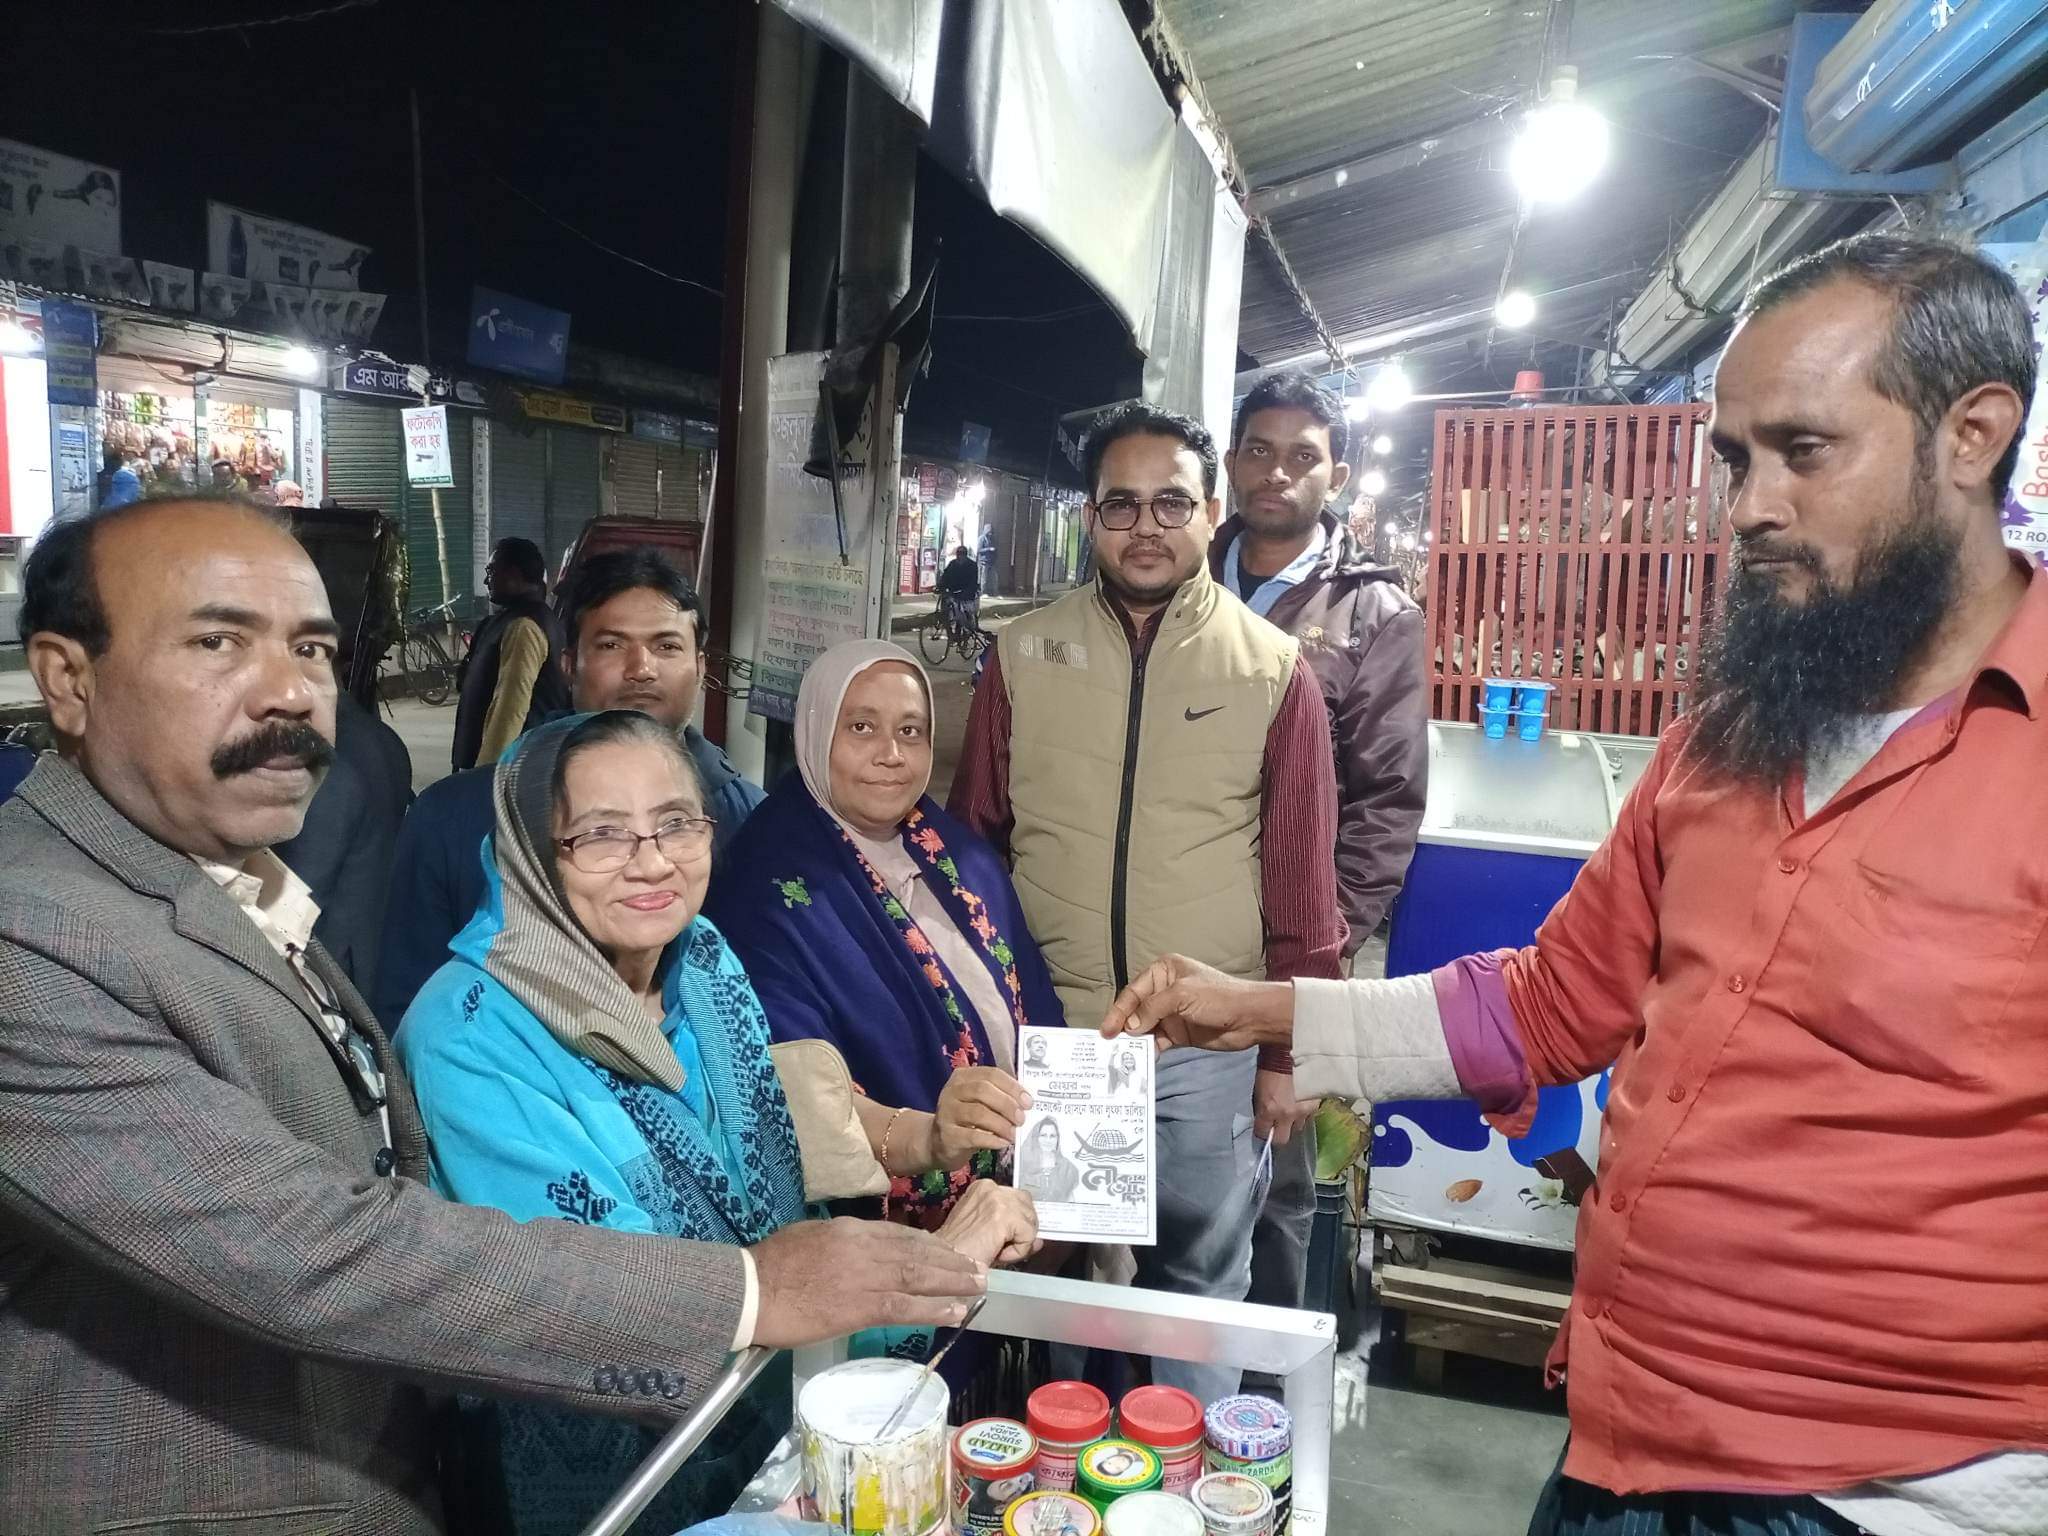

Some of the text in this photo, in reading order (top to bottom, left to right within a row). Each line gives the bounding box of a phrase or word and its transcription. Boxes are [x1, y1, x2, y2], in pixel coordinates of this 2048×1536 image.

[354, 367, 378, 387] এম
[406, 411, 442, 431] ফটোকপি
[409, 435, 441, 449] করা হয়
[2008, 530, 2048, 543] 12 RO
[1049, 1081, 1078, 1091] মেয়র
[979, 1431, 1023, 1445] SUROVI
[1247, 1464, 1275, 1477] ZARDA
